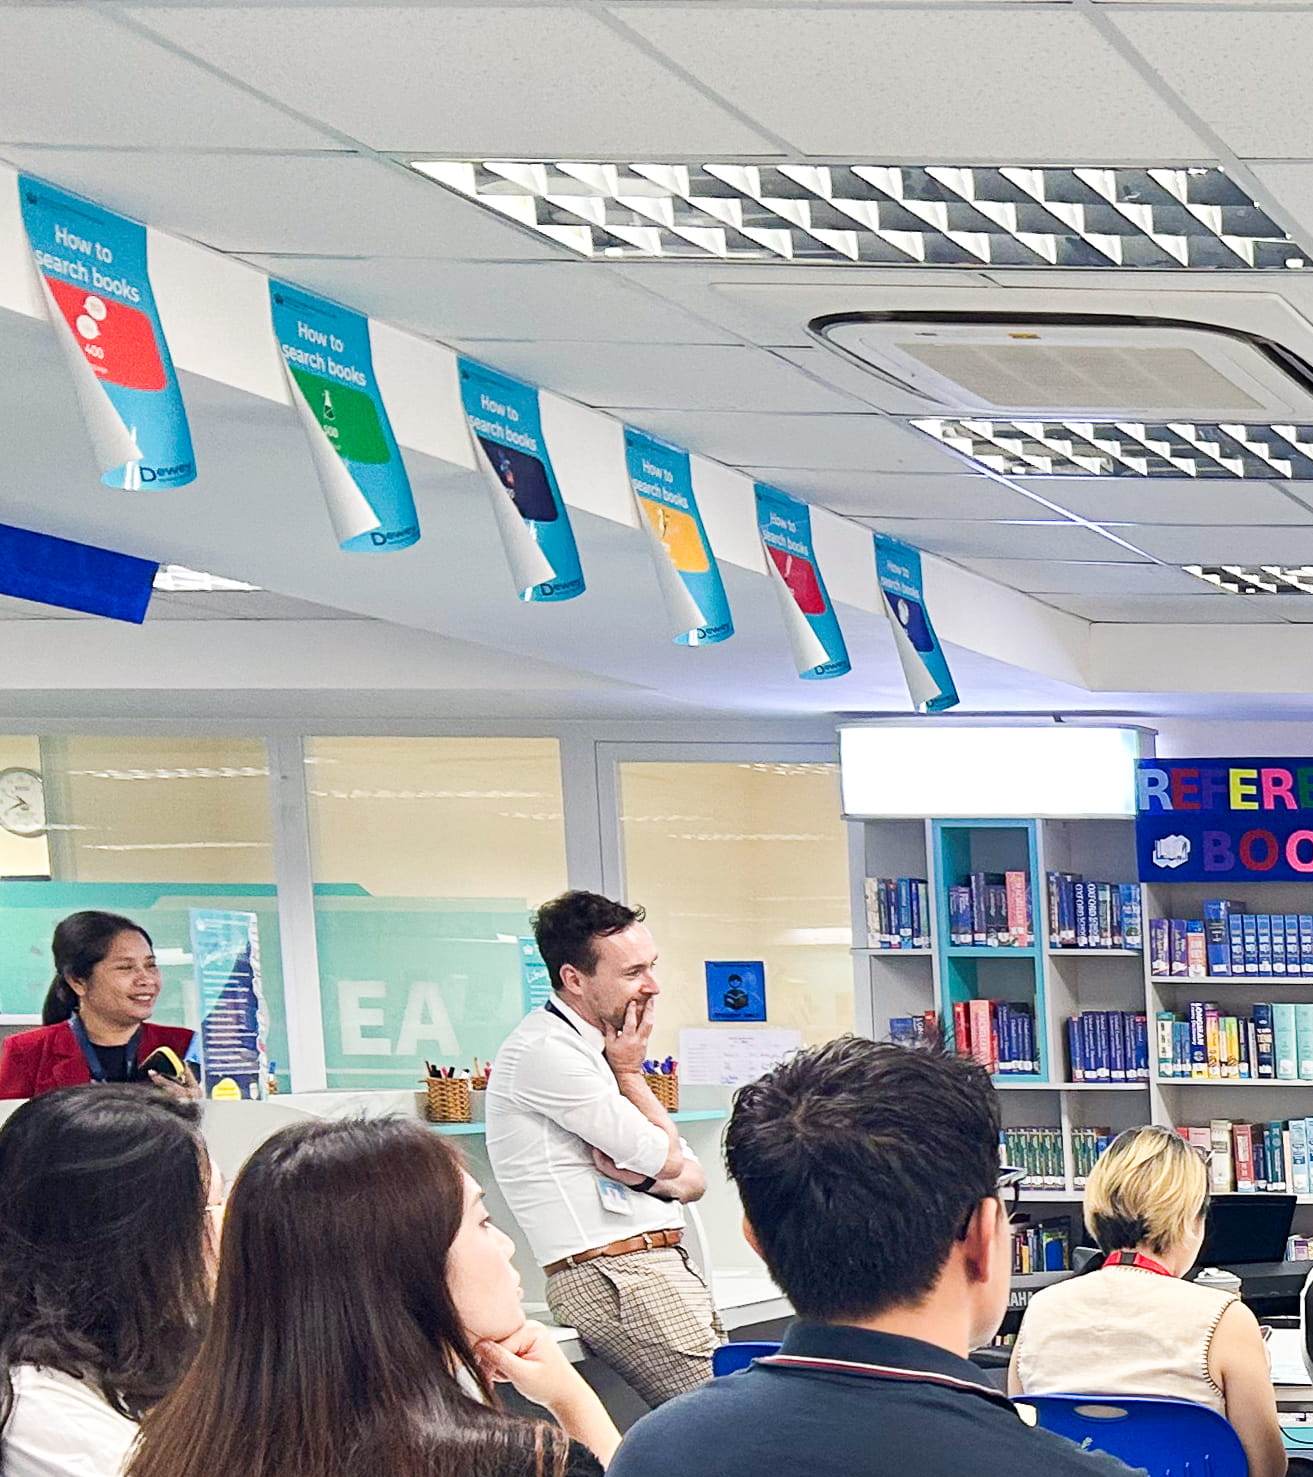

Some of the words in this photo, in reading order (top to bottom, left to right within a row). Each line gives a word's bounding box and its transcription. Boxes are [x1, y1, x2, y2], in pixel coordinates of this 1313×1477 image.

[54, 224, 91, 255] How
[95, 243, 112, 263] to
[34, 249, 89, 283] search
[93, 267, 141, 303] books
[297, 321, 328, 346] How
[329, 335, 344, 352] to
[281, 344, 326, 373] search
[328, 359, 367, 387] books
[480, 393, 505, 416] How
[507, 405, 518, 422] to
[468, 414, 504, 439] search
[505, 426, 537, 451] books
[642, 458, 663, 478] How
[664, 469, 673, 483] to
[632, 478, 662, 497] search
[663, 487, 688, 509] books
